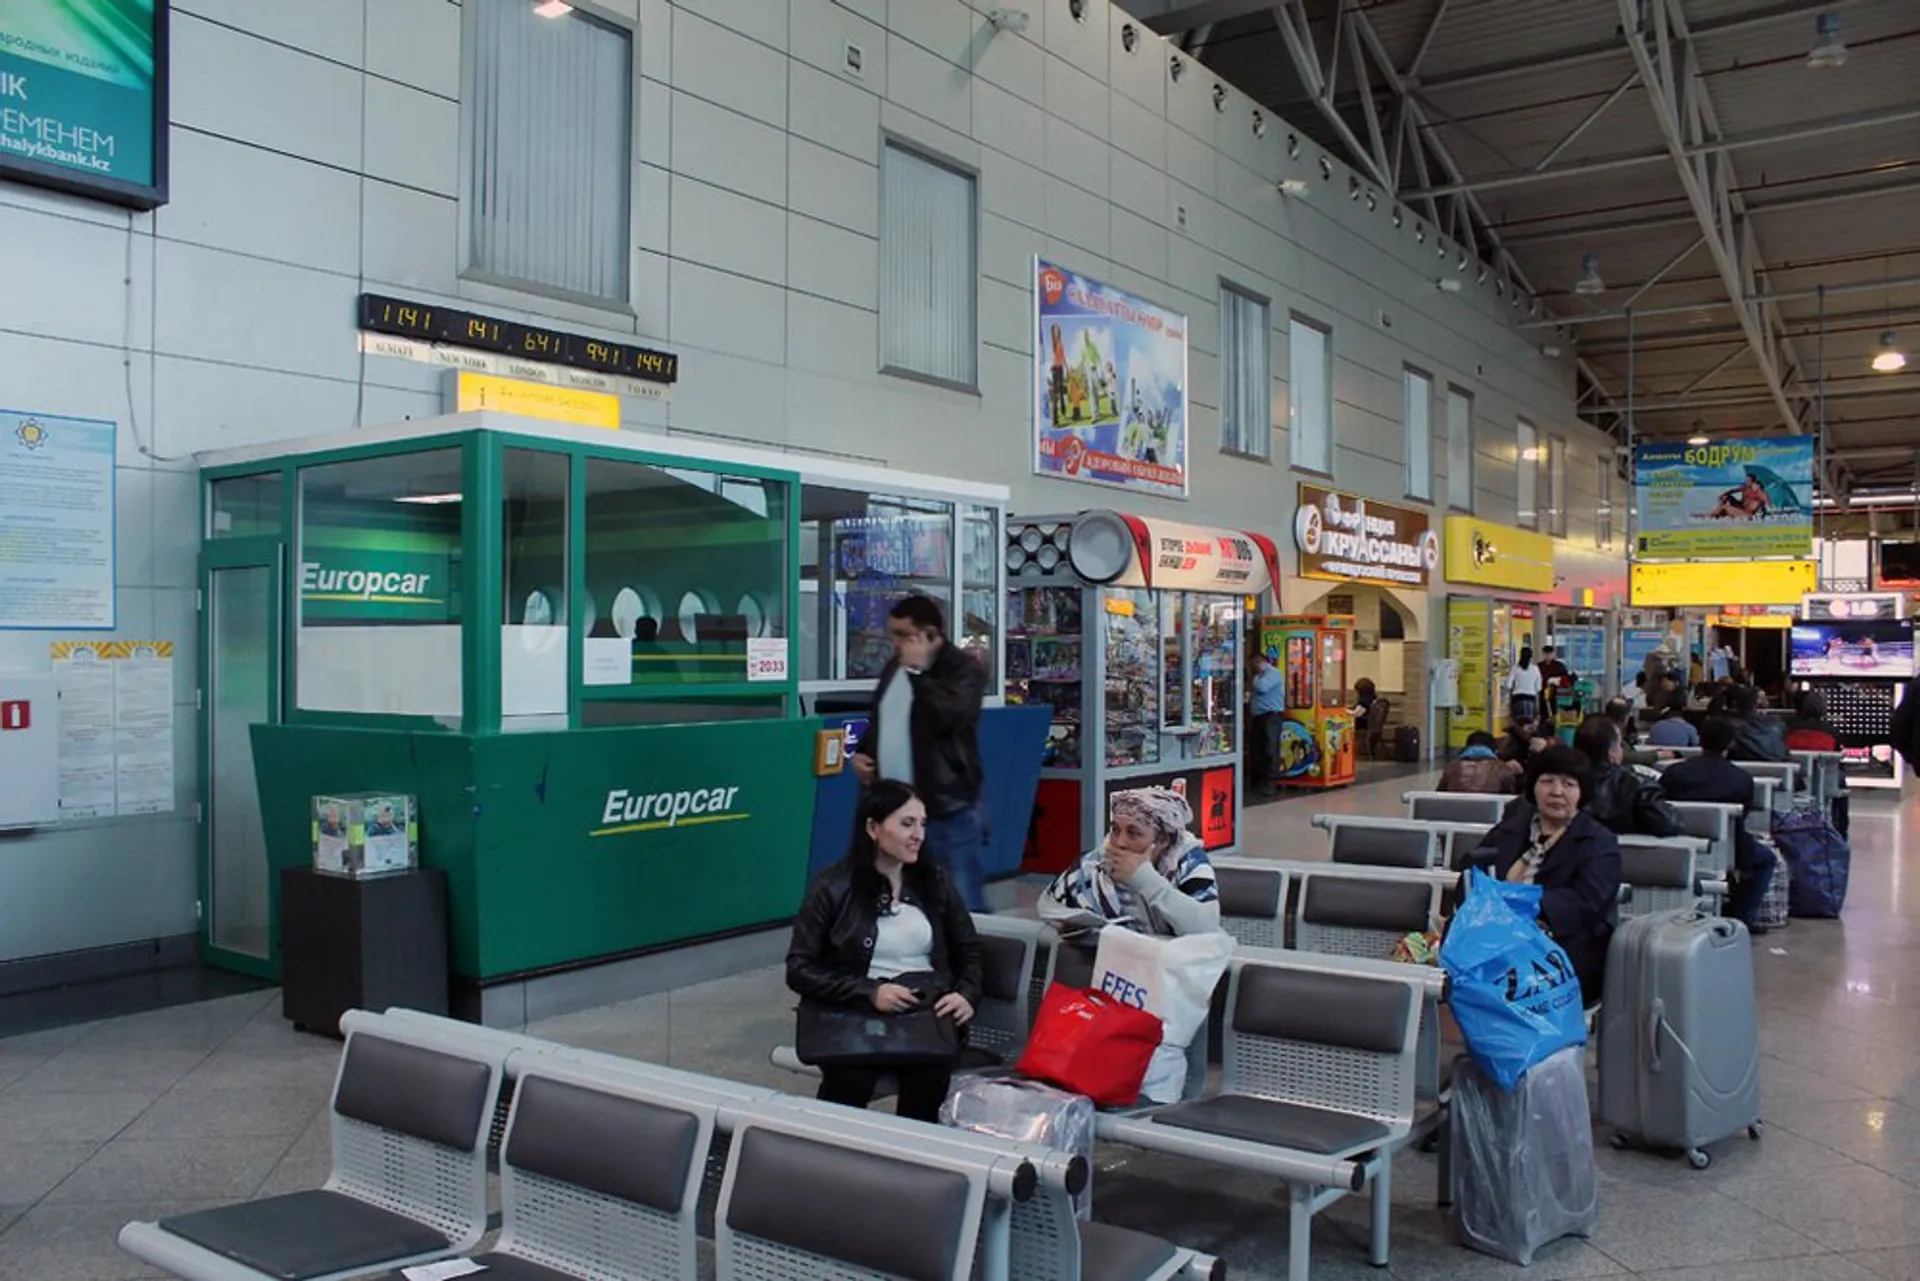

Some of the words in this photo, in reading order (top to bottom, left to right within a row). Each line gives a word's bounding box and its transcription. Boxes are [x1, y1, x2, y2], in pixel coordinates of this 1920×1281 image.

[0, 107, 114, 157] ЕМЕНЕМ
[1322, 531, 1421, 568] КРУАССАНЫ
[301, 562, 430, 600] Europcar
[602, 785, 739, 827] Europcar
